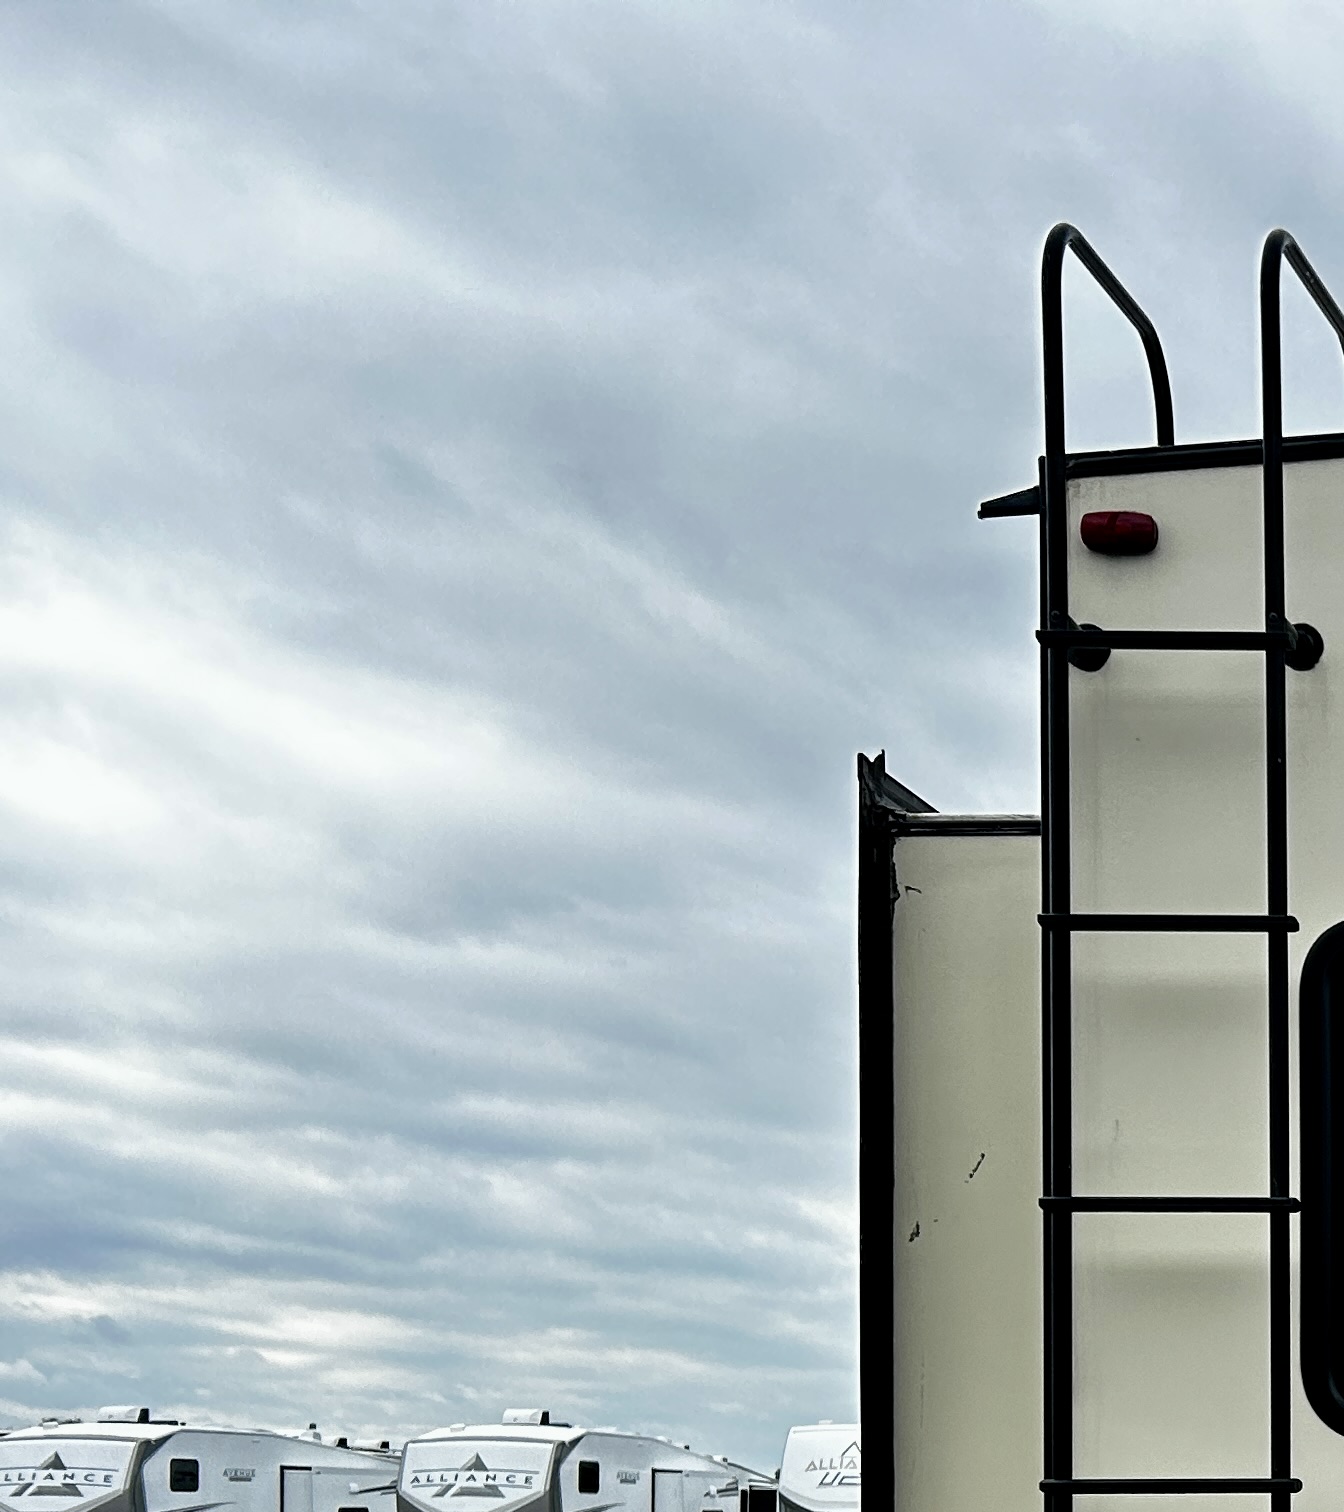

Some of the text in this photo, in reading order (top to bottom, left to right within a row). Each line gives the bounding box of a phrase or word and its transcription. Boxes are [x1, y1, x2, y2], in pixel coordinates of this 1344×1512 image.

[804, 1456, 858, 1472] ALLIA
[4, 1472, 114, 1484] LLIANCE
[409, 1473, 534, 1486] ALLIANCE
